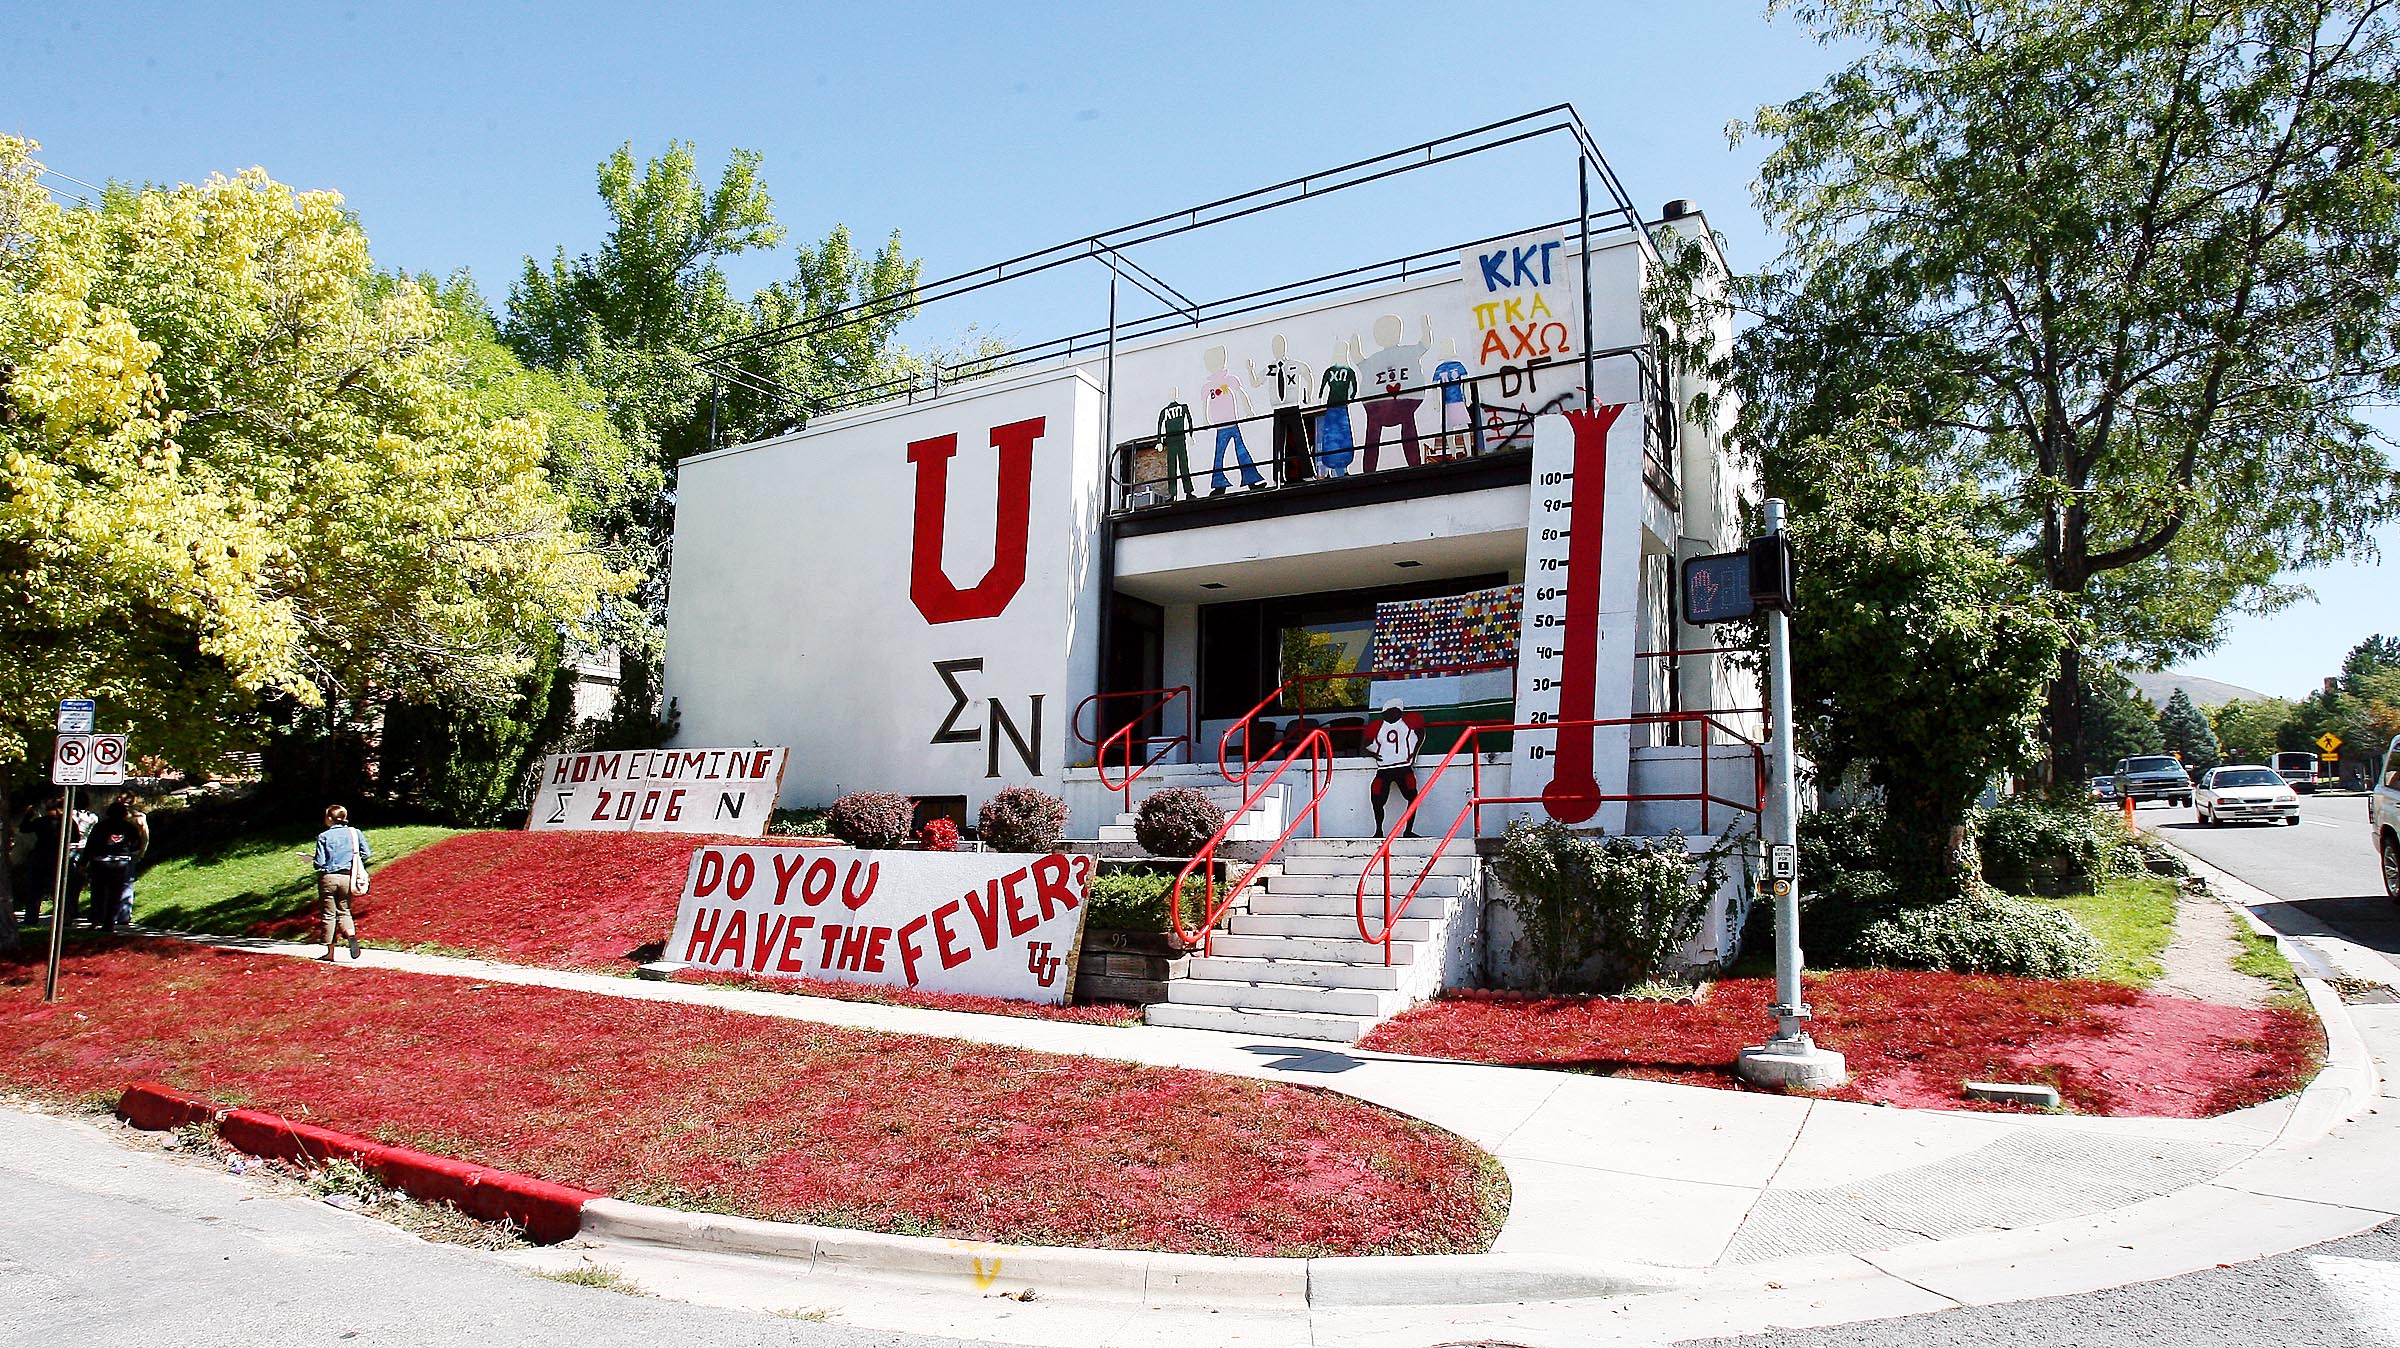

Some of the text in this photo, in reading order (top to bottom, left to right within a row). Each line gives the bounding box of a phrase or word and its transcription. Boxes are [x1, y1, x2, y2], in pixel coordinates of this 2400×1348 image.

[1540, 472, 1561, 485] 100
[1544, 499, 1561, 512] 90
[907, 415, 1046, 625] U
[1542, 529, 1557, 540] 80
[1540, 559, 1556, 570] 70
[1537, 588, 1555, 600] 60
[1534, 615, 1554, 628] 50
[1537, 647, 1552, 659] 40
[1533, 678, 1550, 691] 30
[1531, 712, 1548, 724] 20
[1387, 730, 1399, 754] 9
[1530, 746, 1544, 759] 10
[552, 750, 773, 784] HOMECOMING
[591, 787, 686, 821] 2006
[694, 850, 879, 911] DO YOU
[684, 853, 1091, 988] HAVE THE FEVER?
